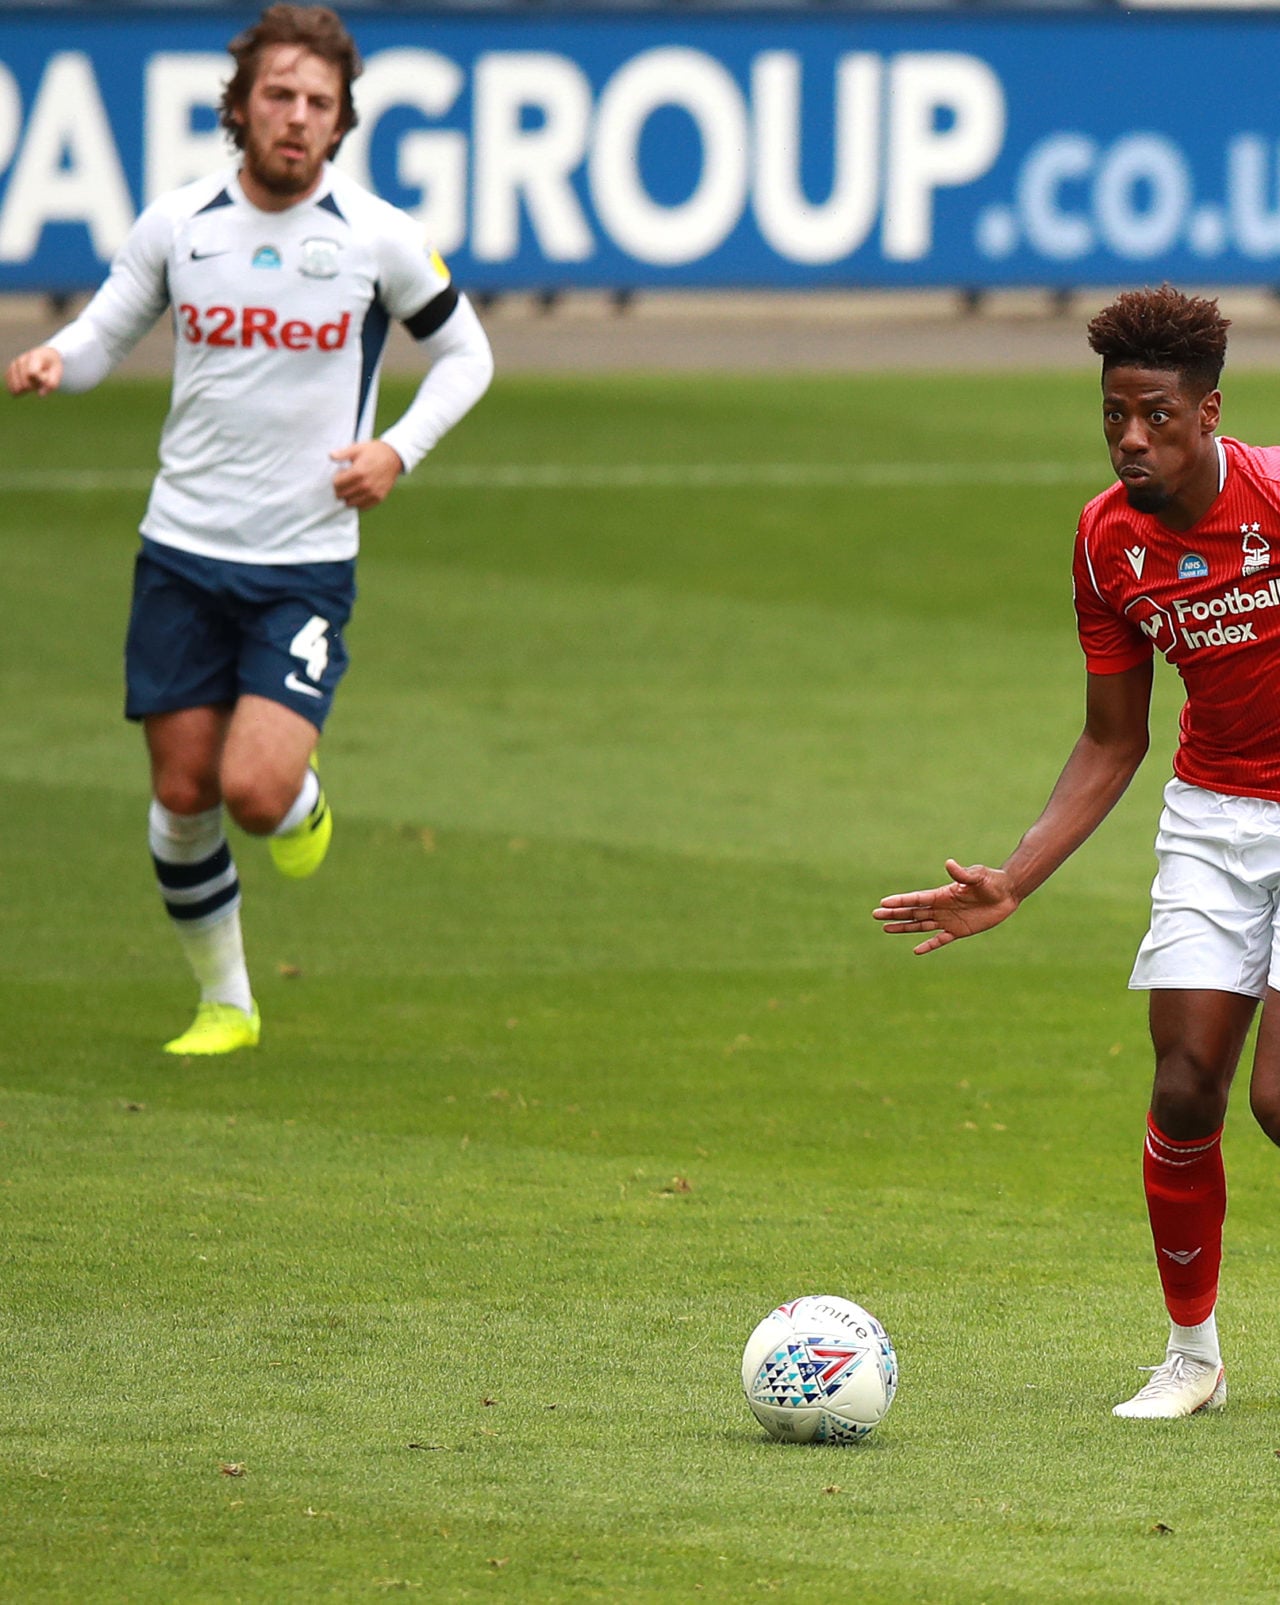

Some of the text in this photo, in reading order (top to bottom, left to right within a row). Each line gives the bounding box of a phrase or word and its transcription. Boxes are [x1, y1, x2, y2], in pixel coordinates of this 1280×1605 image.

[179, 303, 352, 353] 32Red
[289, 614, 330, 682] 4
[1180, 620, 1258, 650] Index
[814, 1304, 868, 1340] mitre
